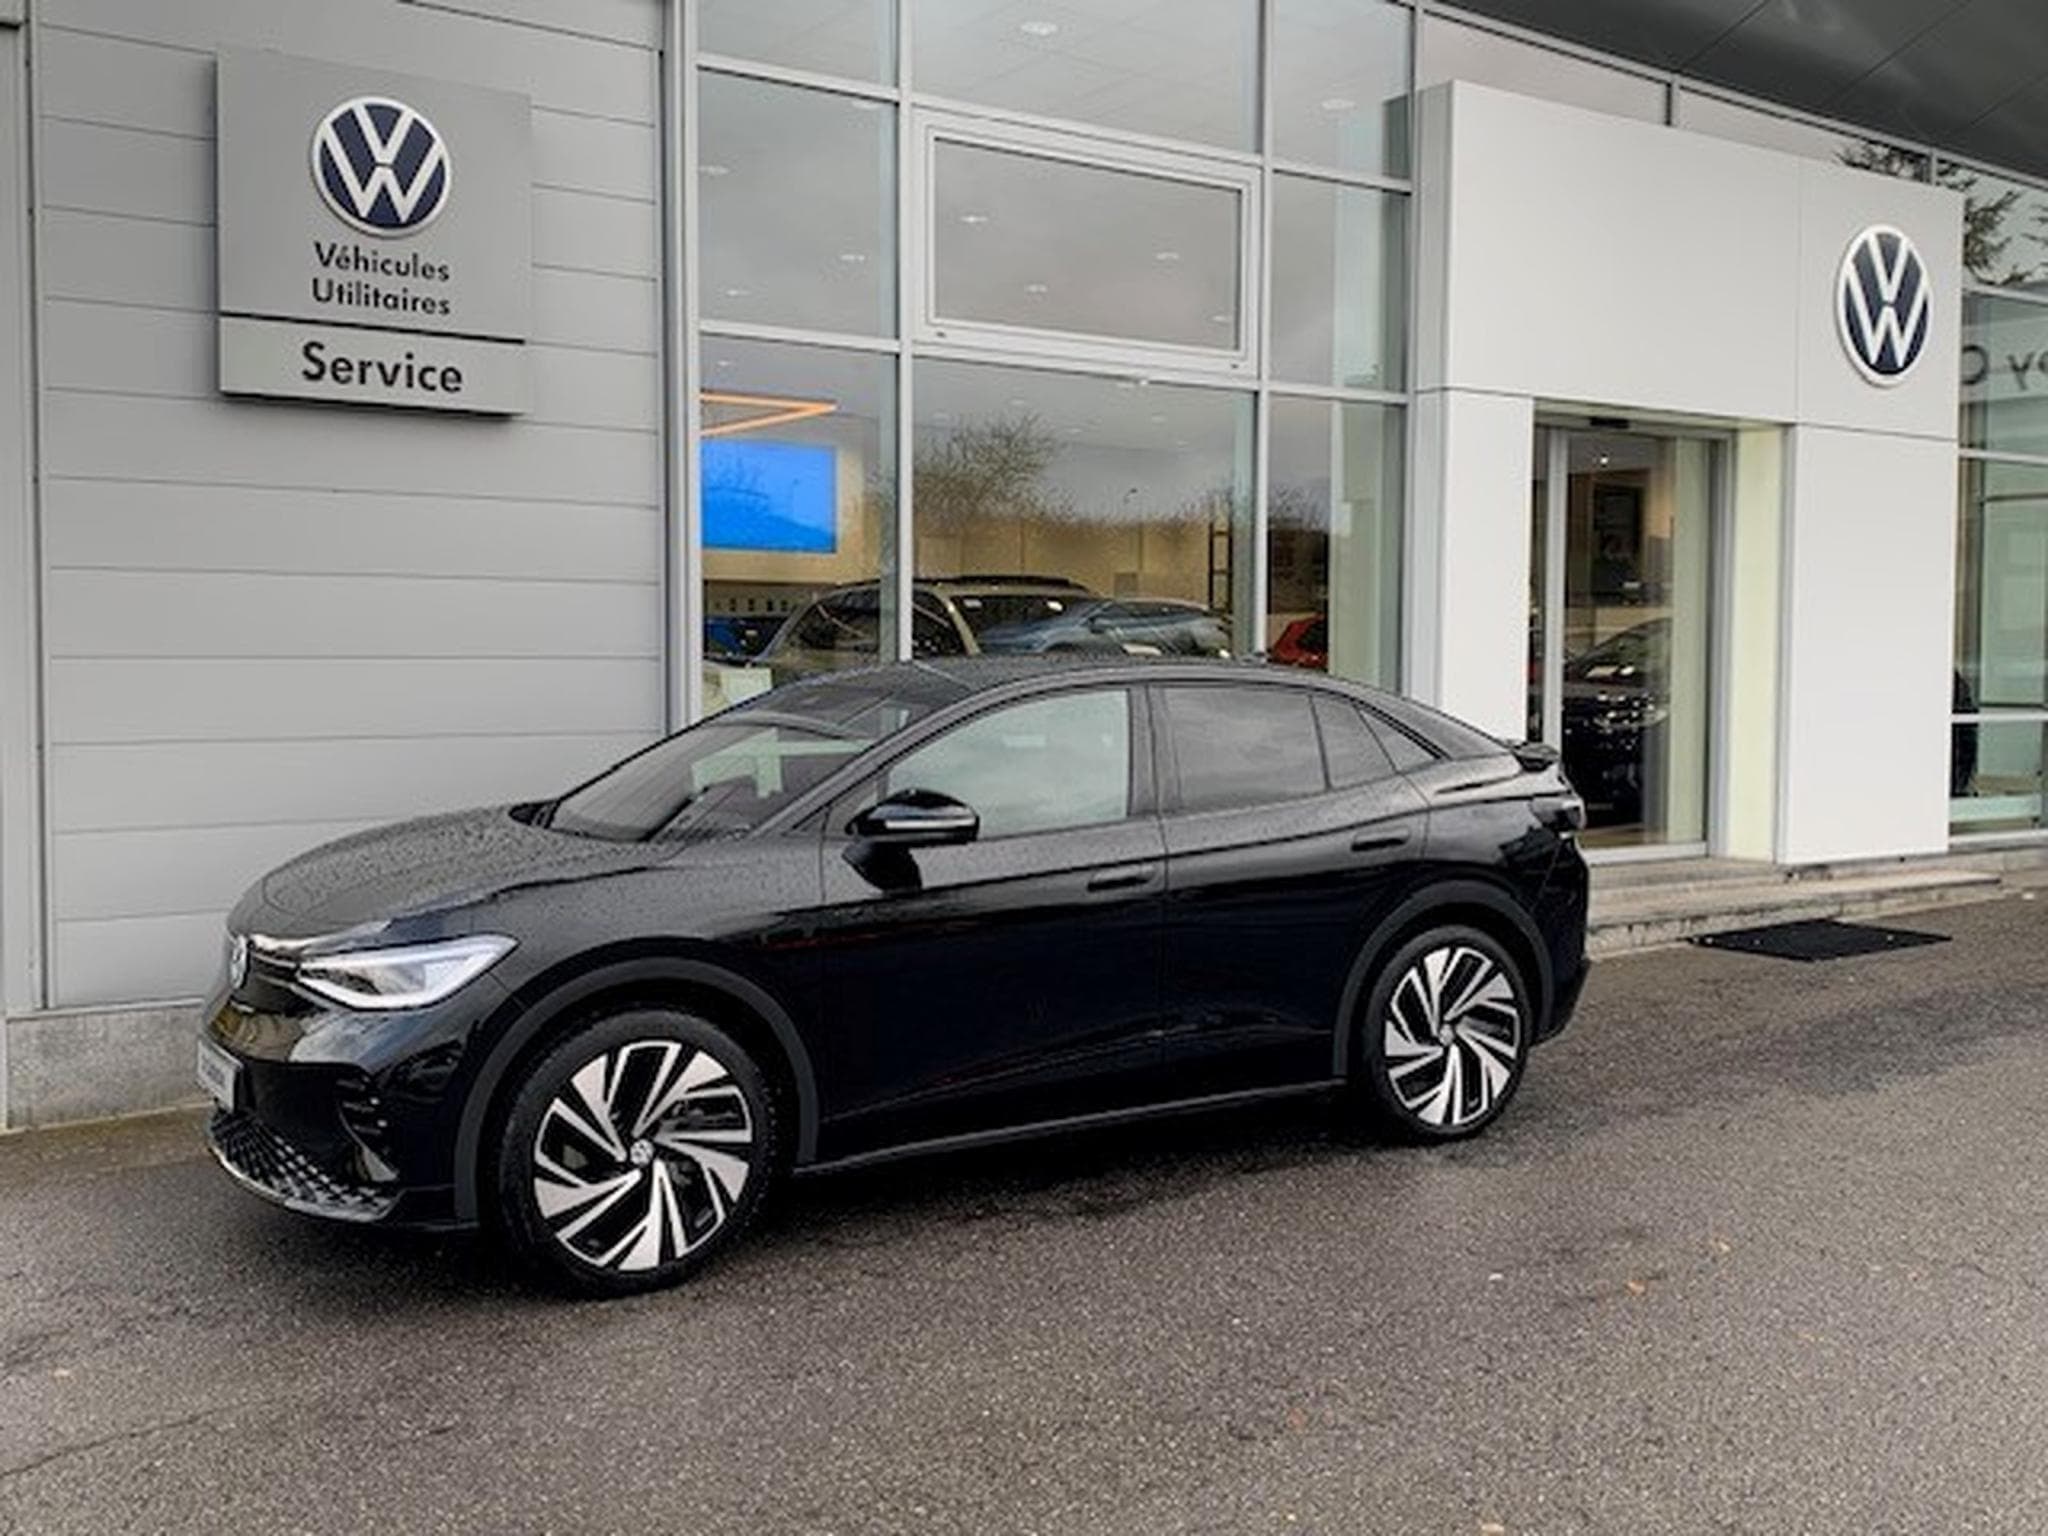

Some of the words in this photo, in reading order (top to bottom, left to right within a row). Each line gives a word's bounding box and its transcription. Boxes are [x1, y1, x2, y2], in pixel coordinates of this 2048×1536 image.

[314, 240, 450, 282] Véhicules
[312, 277, 450, 315] Utilitaires
[302, 341, 463, 393] Service
